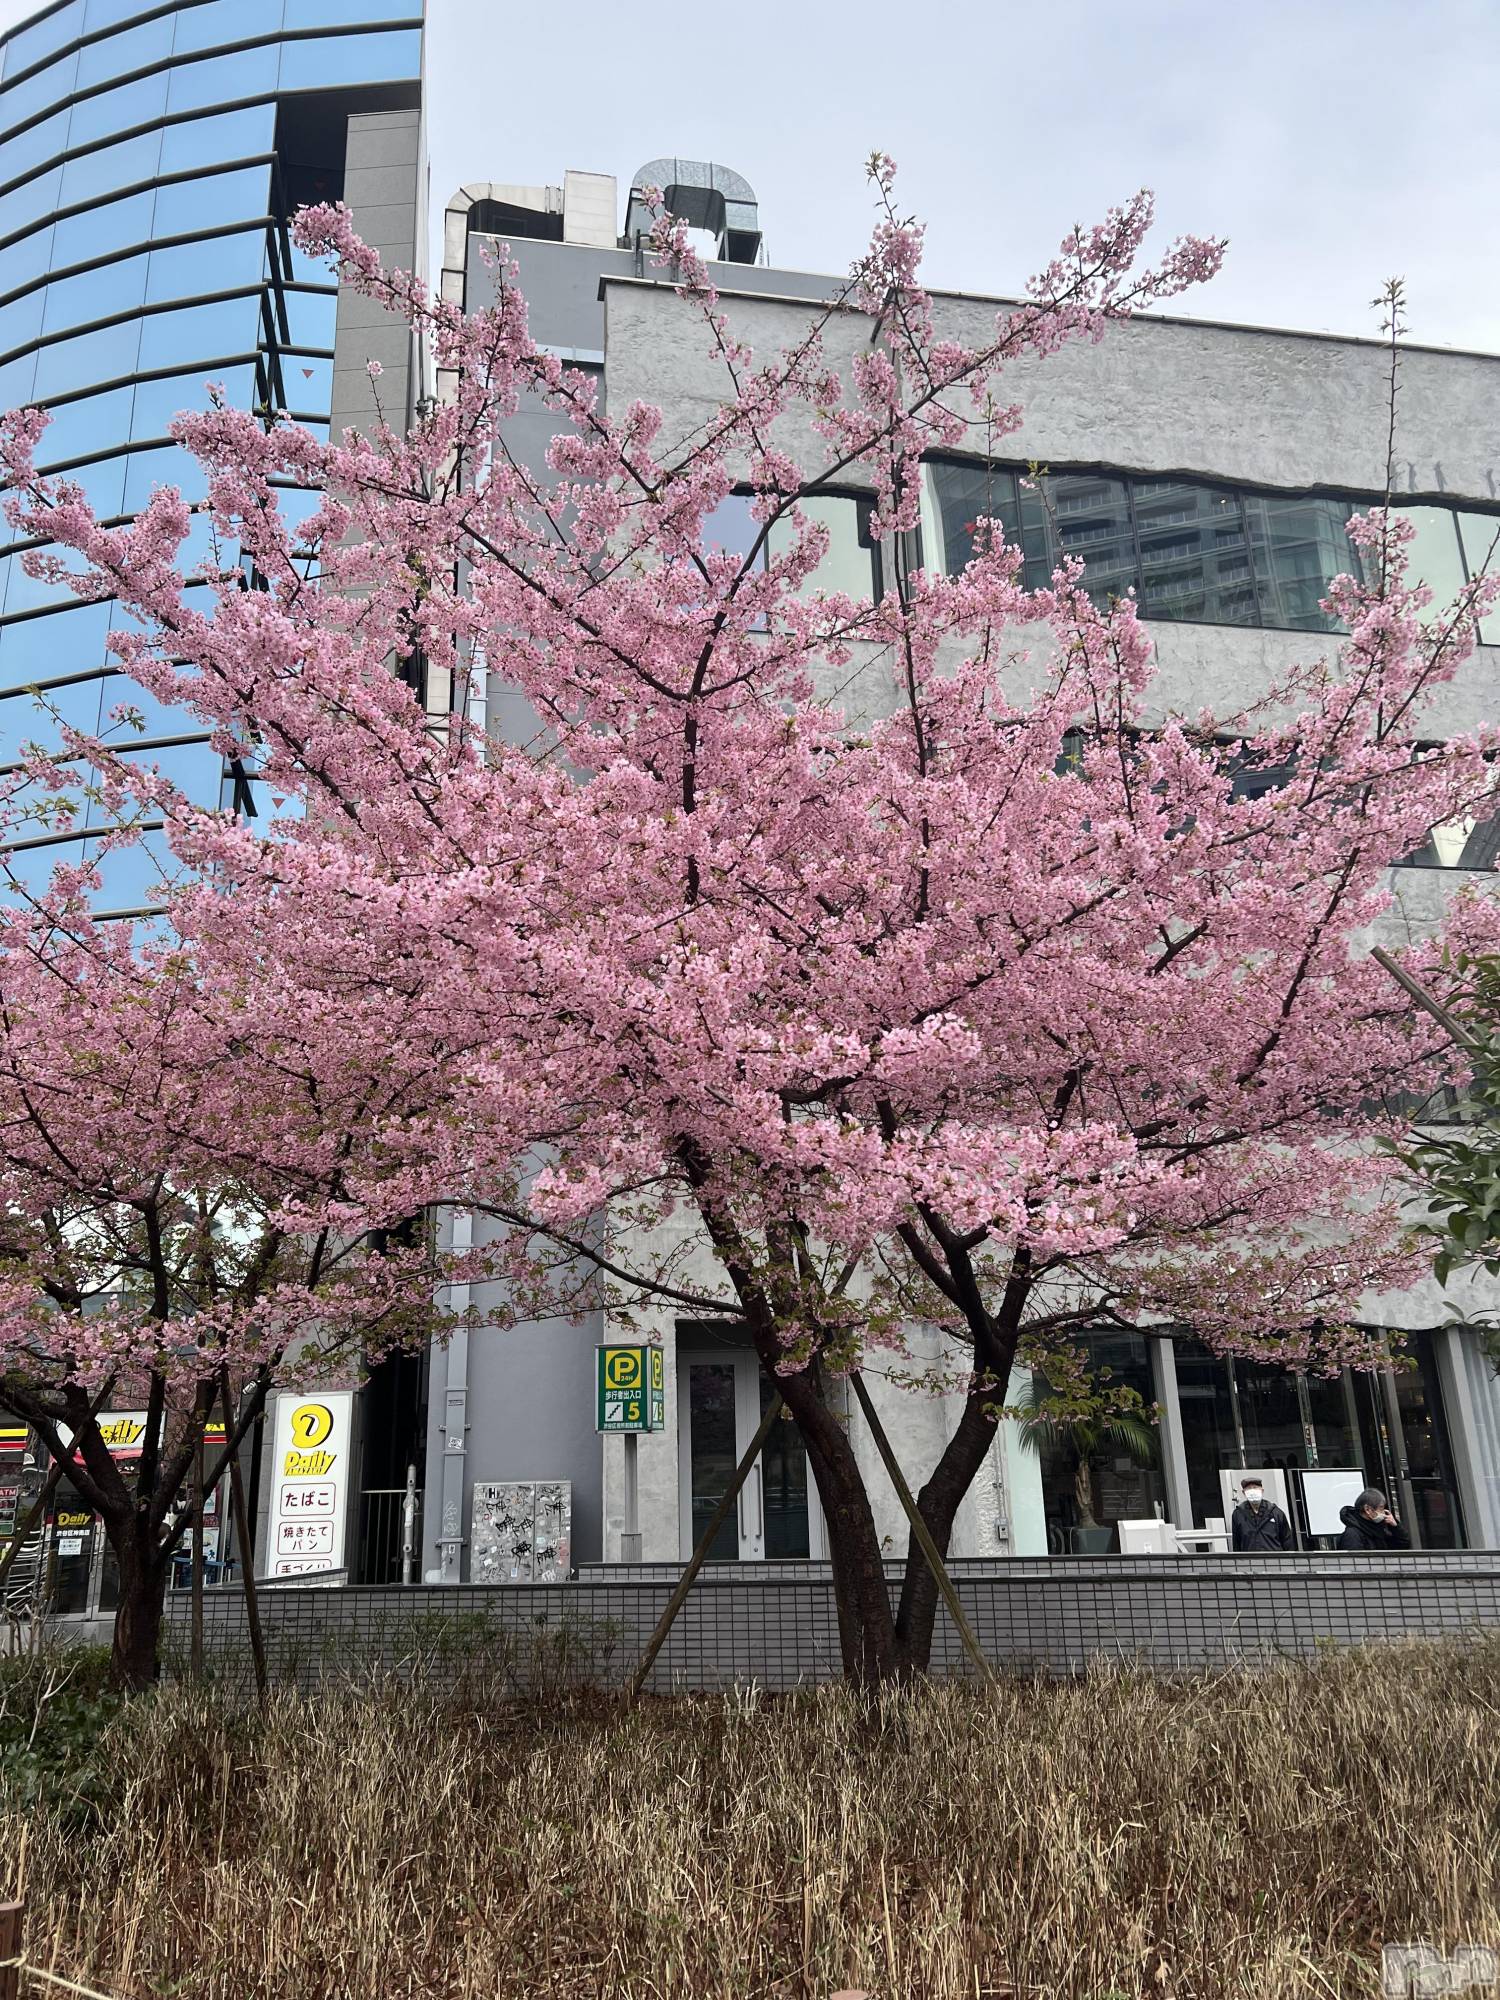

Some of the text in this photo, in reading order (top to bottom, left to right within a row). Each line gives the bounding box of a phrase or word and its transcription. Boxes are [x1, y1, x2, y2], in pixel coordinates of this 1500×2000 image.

[615, 1357, 635, 1382] P
[605, 1390, 641, 1400] 歩行者出入口
[627, 1401, 640, 1421] 5
[99, 1419, 146, 1444] aily
[285, 1450, 337, 1474] Daily
[285, 1491, 329, 1507] たばこ
[58, 1512, 91, 1526] Daily
[284, 1526, 328, 1538] 焼きたて
[292, 1539, 318, 1551] パン
